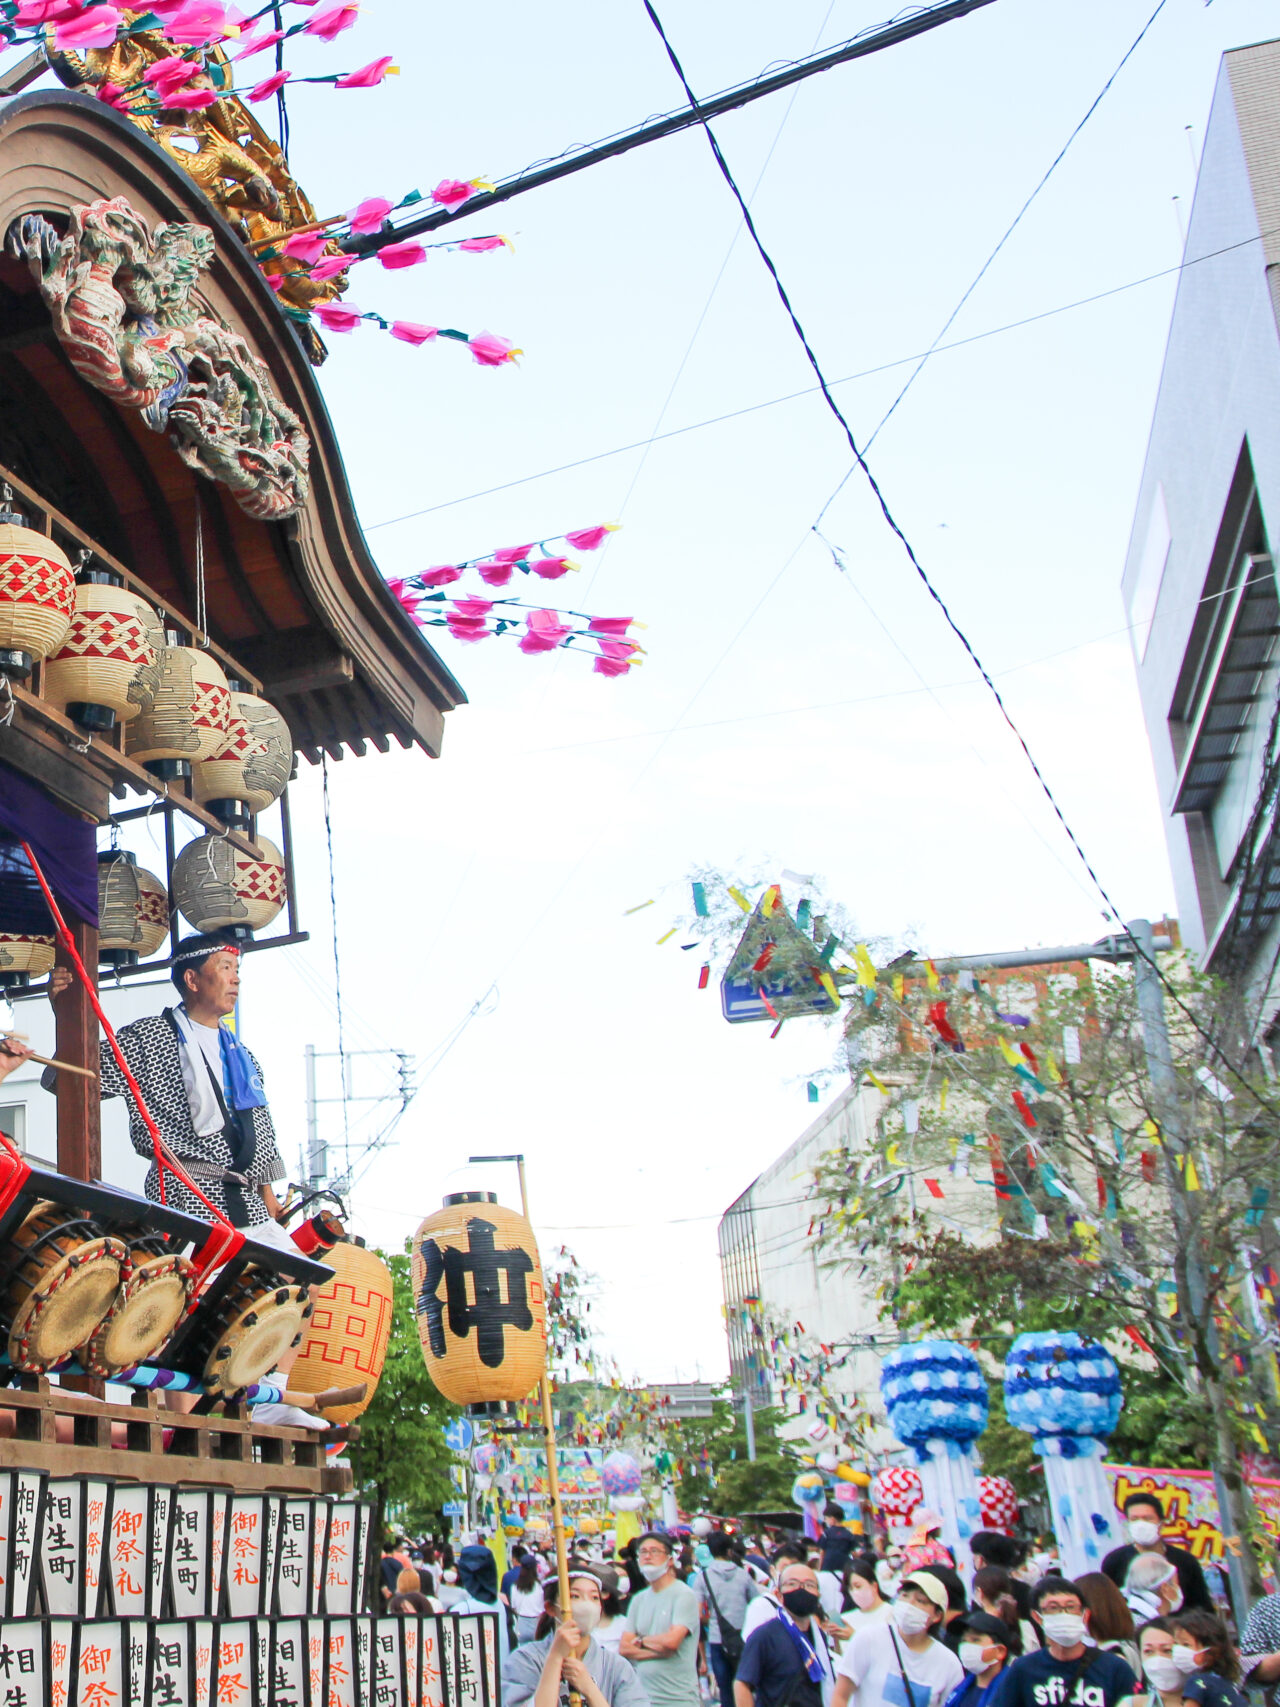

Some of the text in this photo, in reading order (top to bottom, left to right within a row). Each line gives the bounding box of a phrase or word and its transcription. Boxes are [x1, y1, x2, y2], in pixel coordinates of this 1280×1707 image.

[414, 1215, 535, 1369] 仲
[15, 1481, 35, 1581] 相生町
[45, 1491, 76, 1584] 相生町
[85, 1499, 104, 1588] 御祭礼
[111, 1508, 145, 1596] 御祭礼
[152, 1493, 167, 1586] 相生町
[175, 1505, 199, 1595] 相生町
[230, 1511, 259, 1586] 御祭礼
[282, 1513, 304, 1588] 相生町
[326, 1518, 351, 1586] 御祭礼
